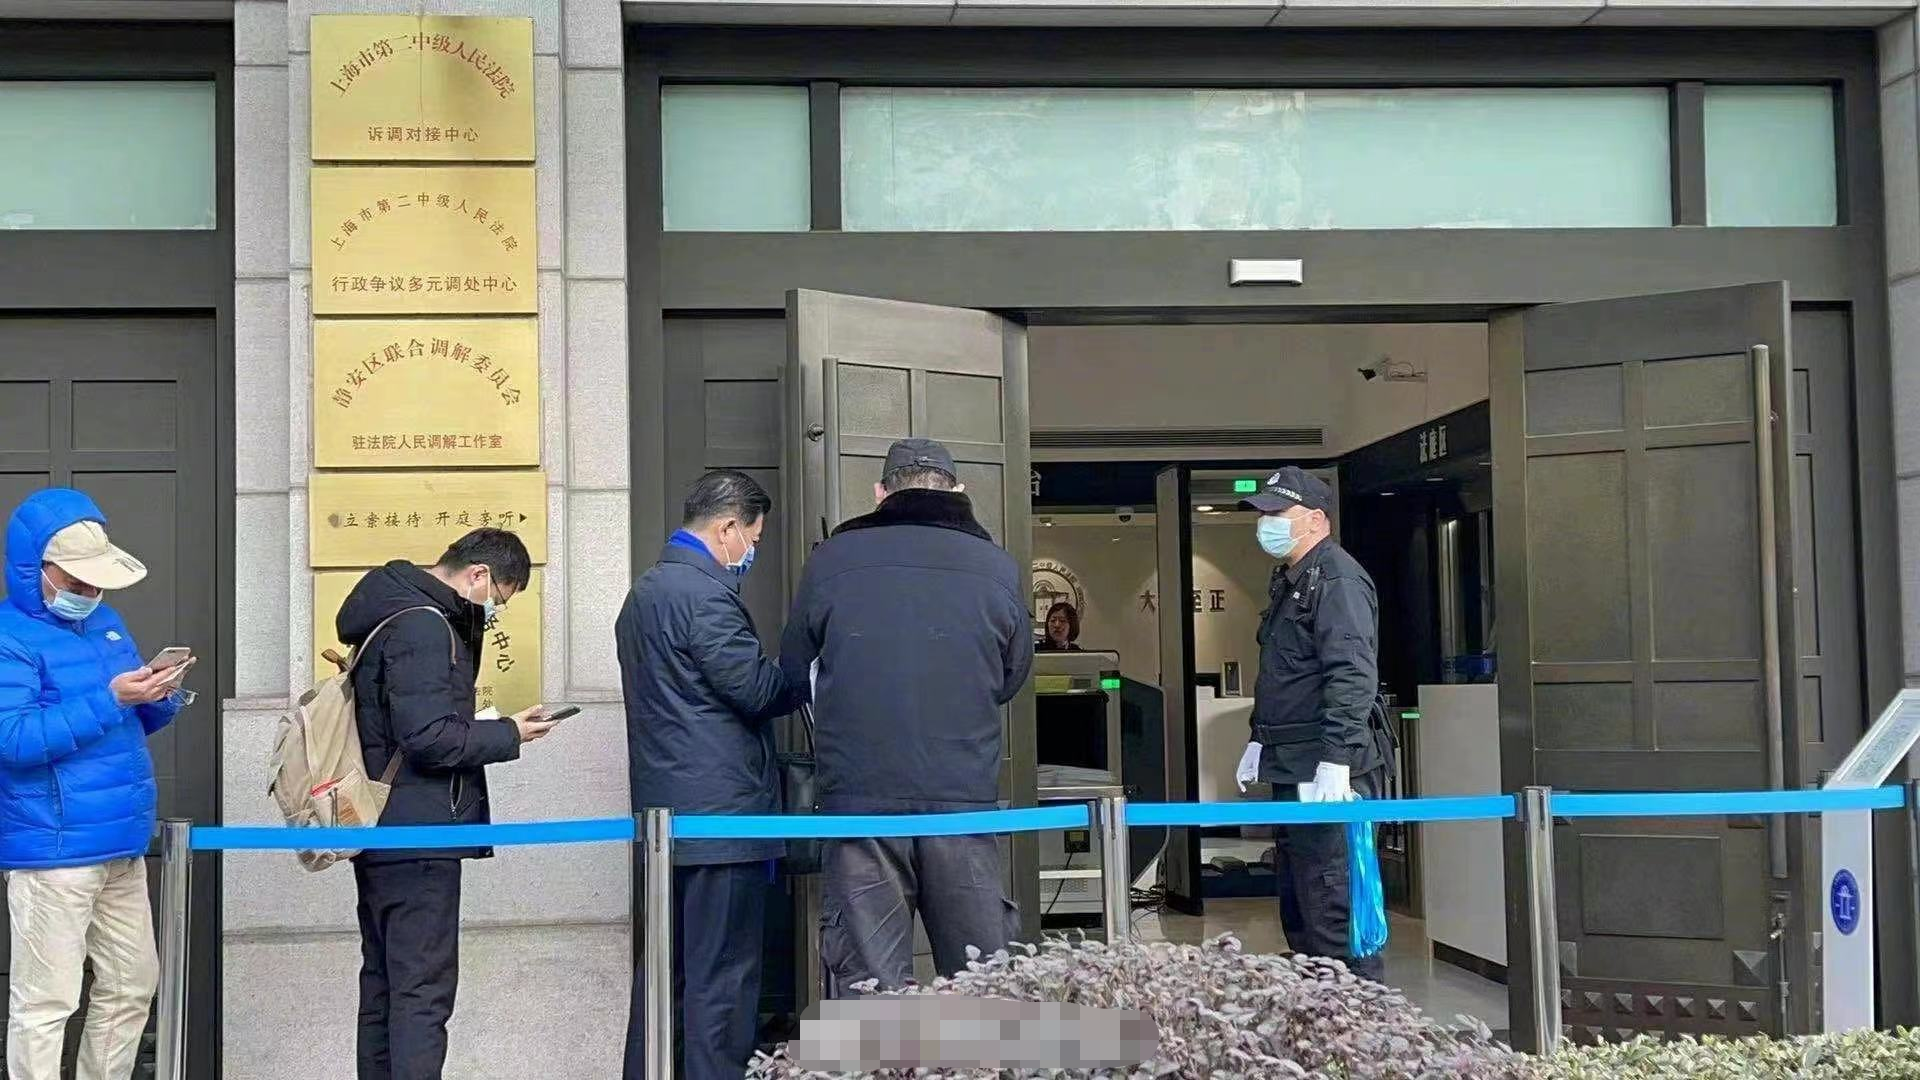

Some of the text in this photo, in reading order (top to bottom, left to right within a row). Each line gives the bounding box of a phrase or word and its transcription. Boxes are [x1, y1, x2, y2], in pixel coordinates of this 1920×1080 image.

[330, 32, 516, 99] 上海市第二中级人民法院
[367, 126, 479, 142] 诉调对接中心
[330, 192, 519, 252] 上海市第二中级人民法院
[331, 276, 517, 292] 行政争议多元调处中心
[332, 337, 521, 408] 静安区联合调解委员会
[352, 434, 503, 450] 驻法院人民调解工作室
[343, 510, 516, 528] 立案接待 开庭旁听
[1139, 589, 1225, 613] 大至正
